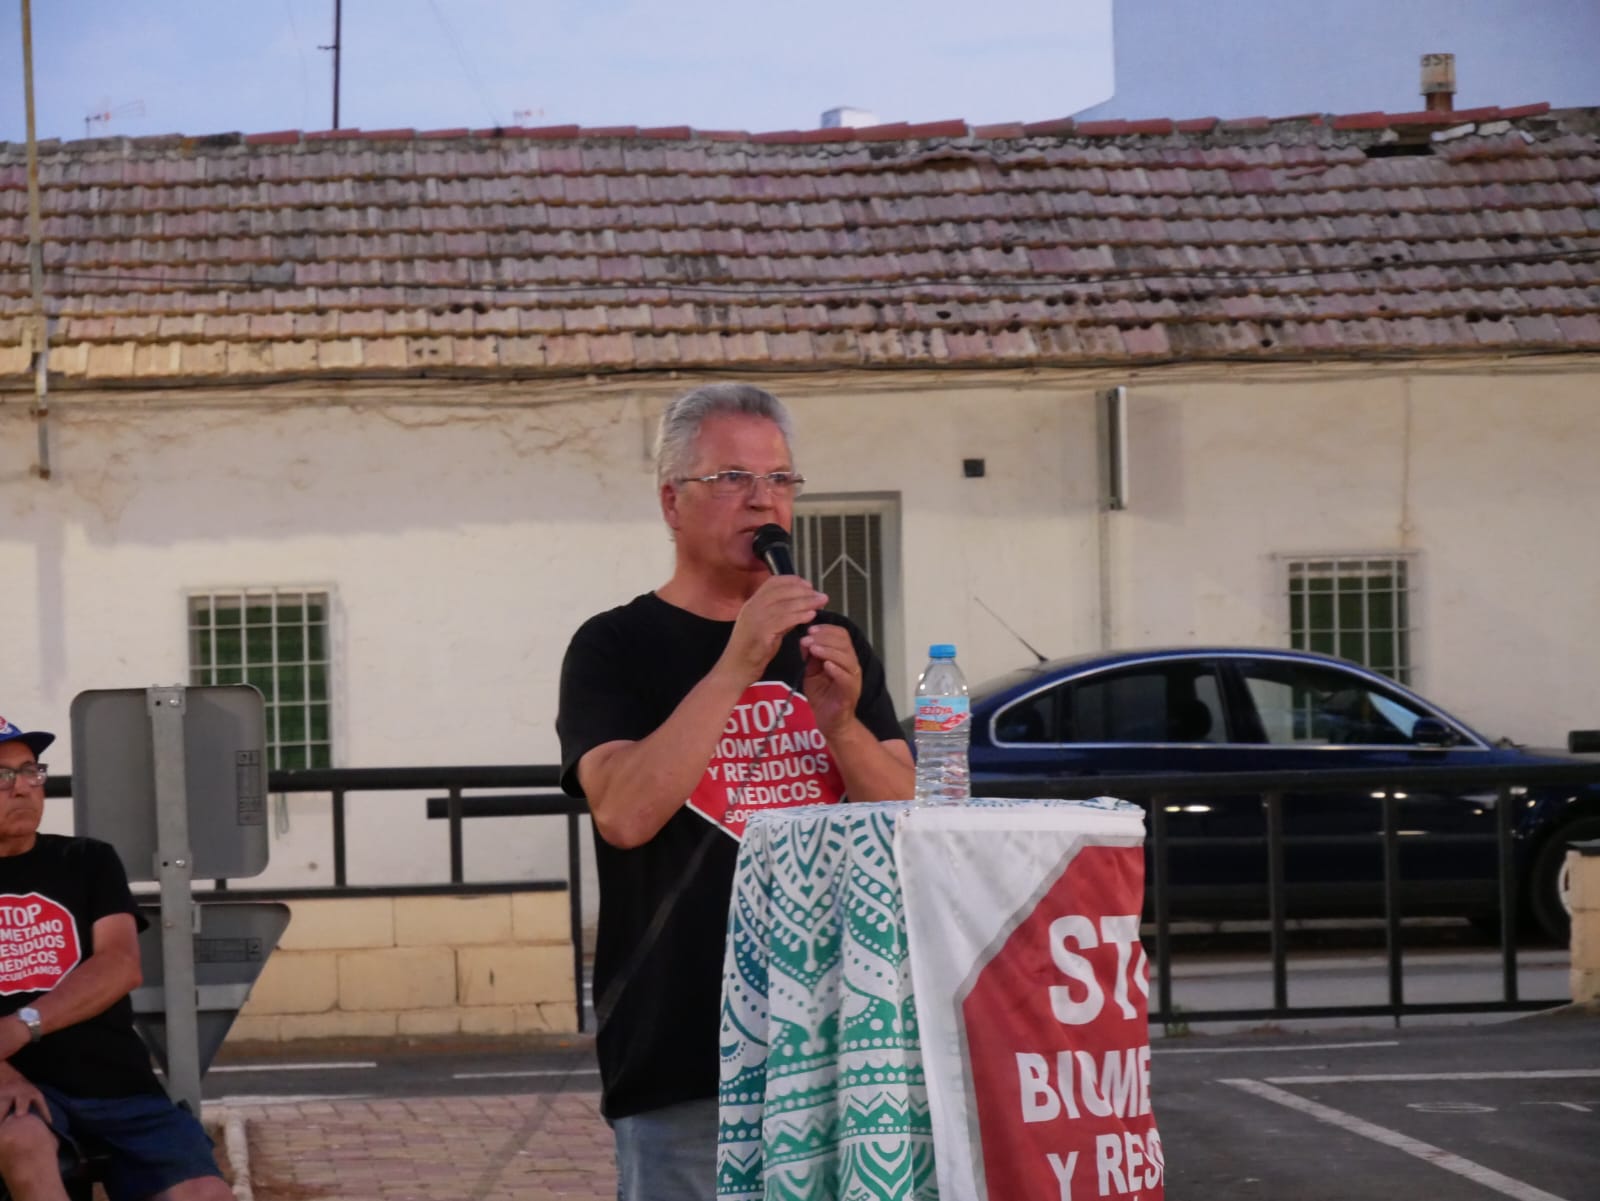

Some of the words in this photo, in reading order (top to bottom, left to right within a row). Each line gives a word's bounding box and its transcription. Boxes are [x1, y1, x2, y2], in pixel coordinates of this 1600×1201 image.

[711, 729, 827, 759] IOMETANO
[706, 765, 719, 780] Y
[723, 753, 829, 783] RESIDUOS
[726, 779, 821, 805] MÉDICOS
[1046, 1151, 1080, 1201] Y
